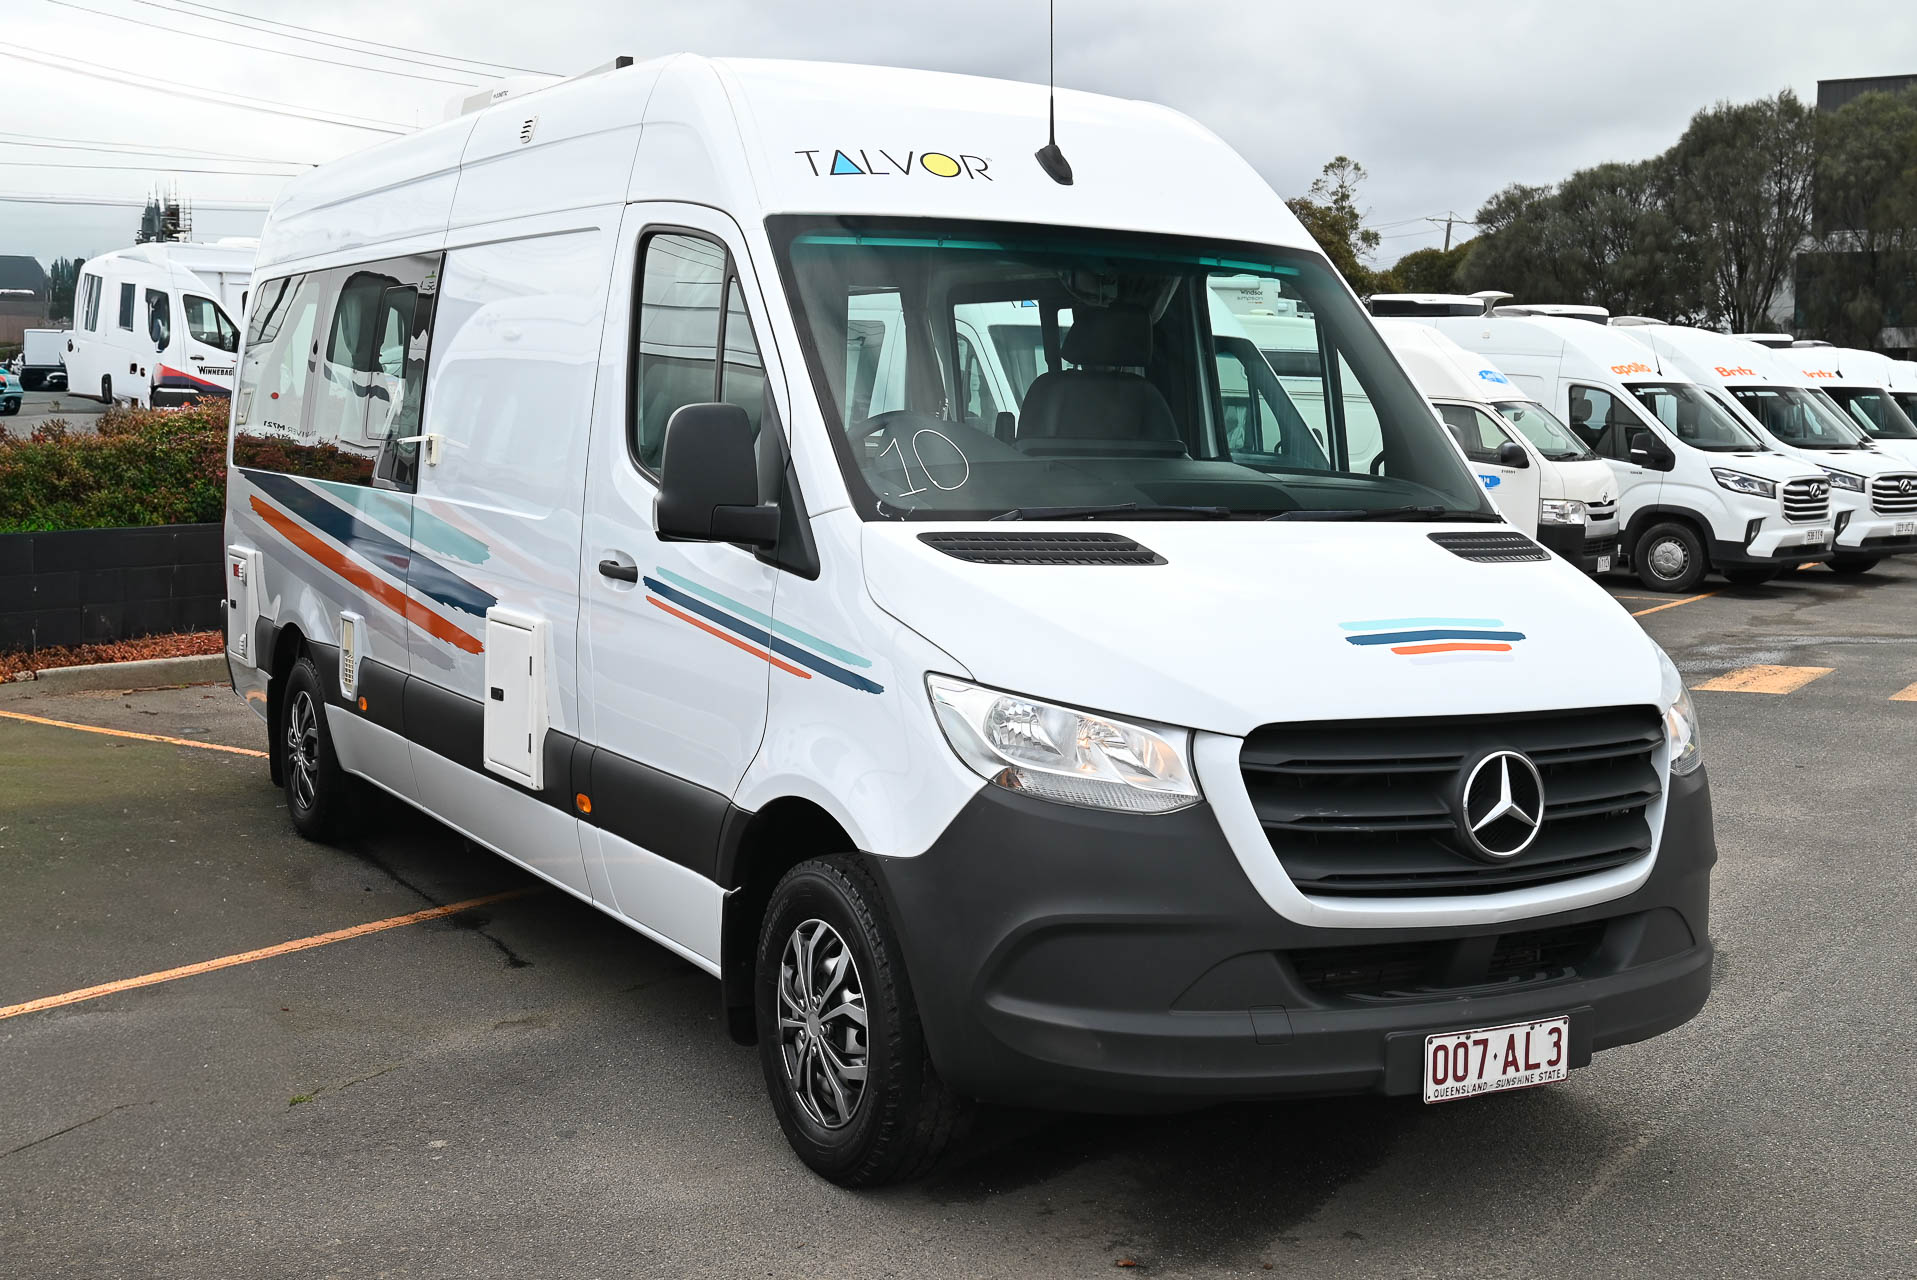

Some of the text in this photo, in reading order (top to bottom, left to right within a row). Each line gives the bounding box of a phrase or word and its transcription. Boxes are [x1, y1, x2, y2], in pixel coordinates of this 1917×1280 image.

[794, 150, 993, 181] TALVOR
[197, 365, 235, 376] WINNEBAG
[1714, 366, 1757, 377] Britz
[880, 429, 970, 498] 10
[1433, 1082, 1488, 1098] QUEENSLAND
[1495, 1073, 1535, 1089] SUNSHINE
[1538, 1068, 1561, 1082] STATE
